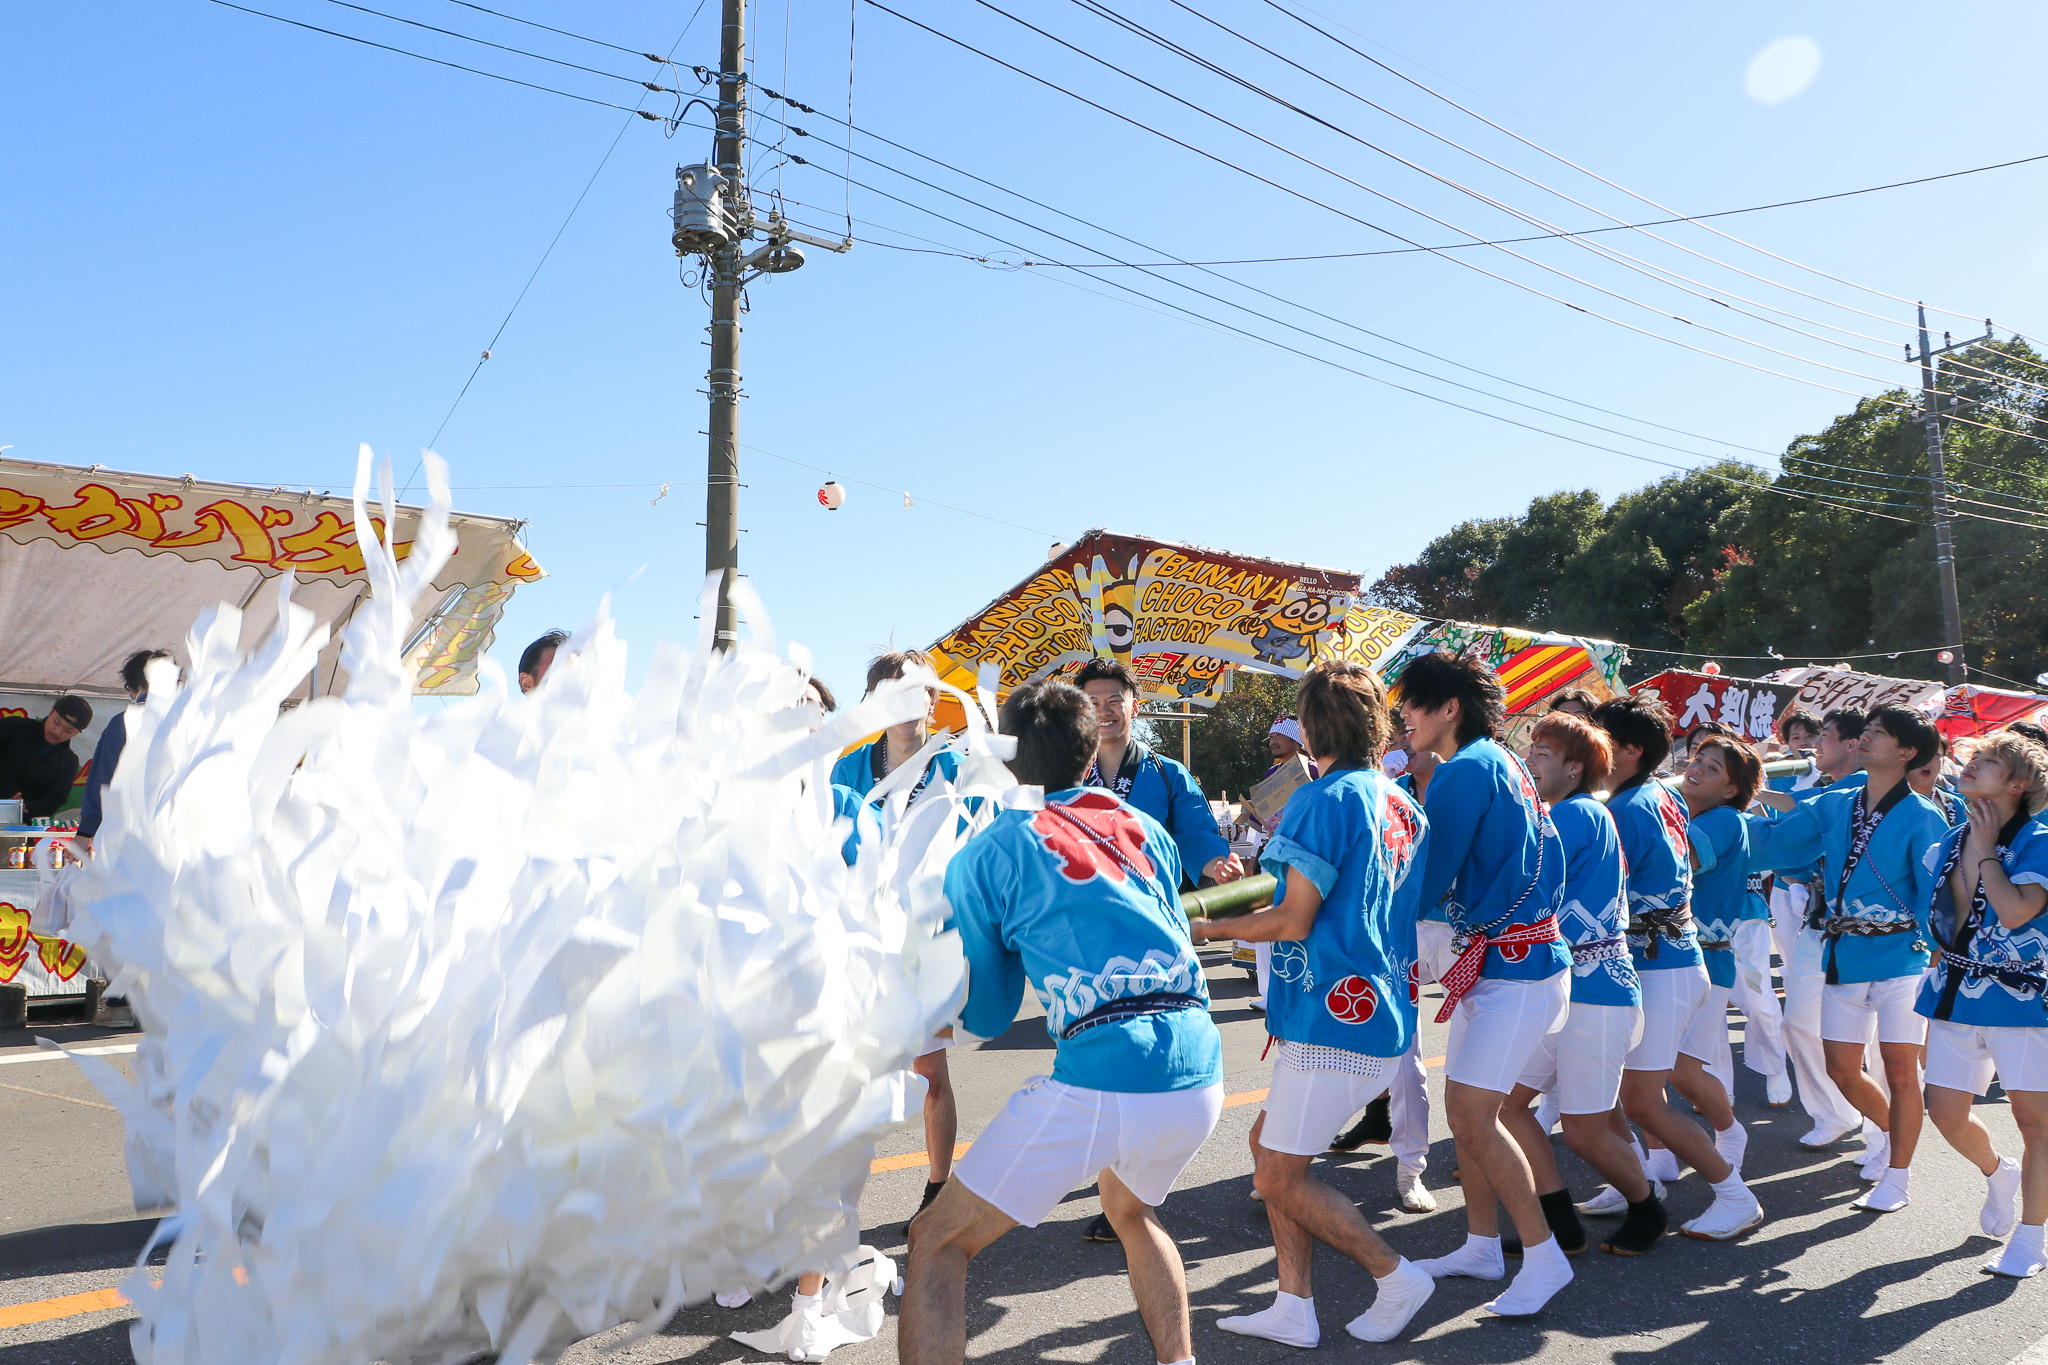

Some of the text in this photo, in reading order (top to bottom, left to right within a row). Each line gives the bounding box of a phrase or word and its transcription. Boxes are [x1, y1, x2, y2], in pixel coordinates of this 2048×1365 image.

[1141, 580, 1245, 620] CHOCO
[1155, 552, 1289, 606] BANANA
[1299, 576, 1318, 585] BELLO
[949, 568, 1077, 660] BANANA
[1132, 616, 1221, 645] FACTORY
[999, 628, 1091, 688] FACTORY
[1678, 682, 1777, 738] 大判焼
